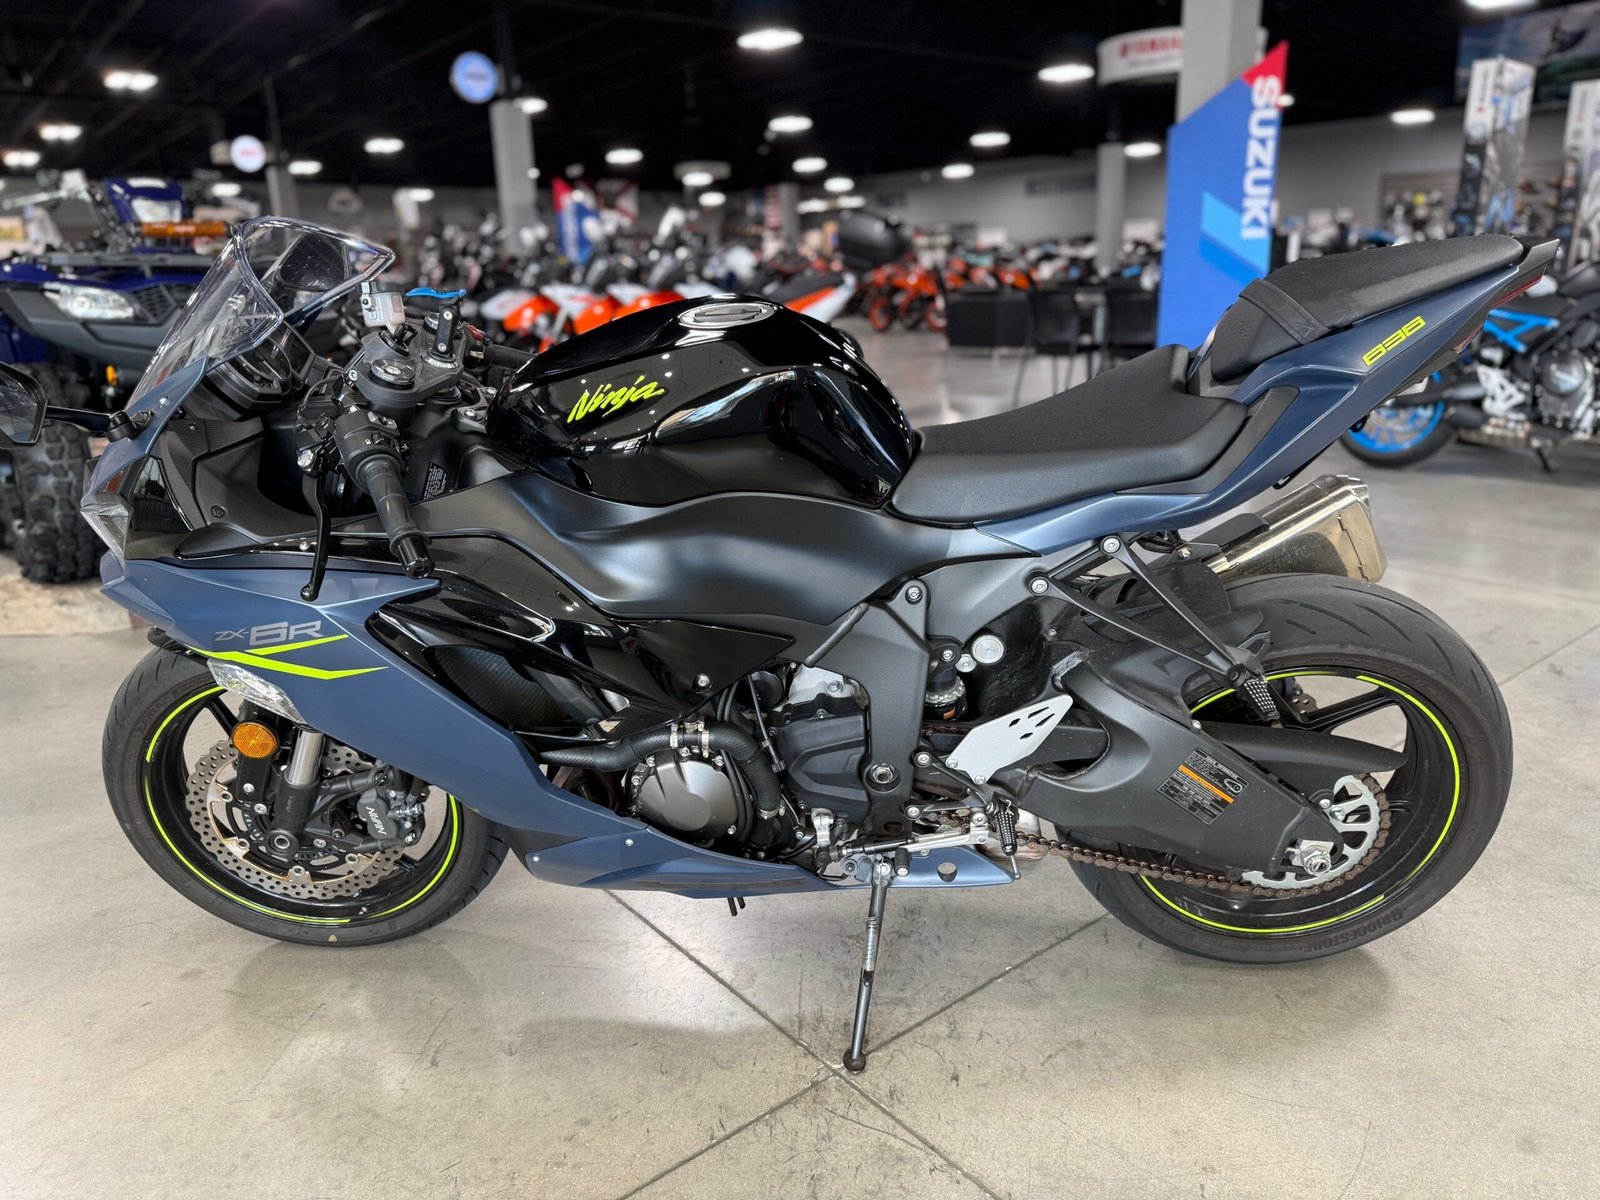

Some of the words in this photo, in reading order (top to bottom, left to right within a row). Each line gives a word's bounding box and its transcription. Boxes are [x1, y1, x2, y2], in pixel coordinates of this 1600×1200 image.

[1241, 75, 1281, 238] SUZUKI
[1362, 316, 1425, 366] 636
[567, 375, 665, 423] Ninja
[365, 806, 387, 835] NISSIN
[1302, 905, 1405, 952] BRIDGESTONE
